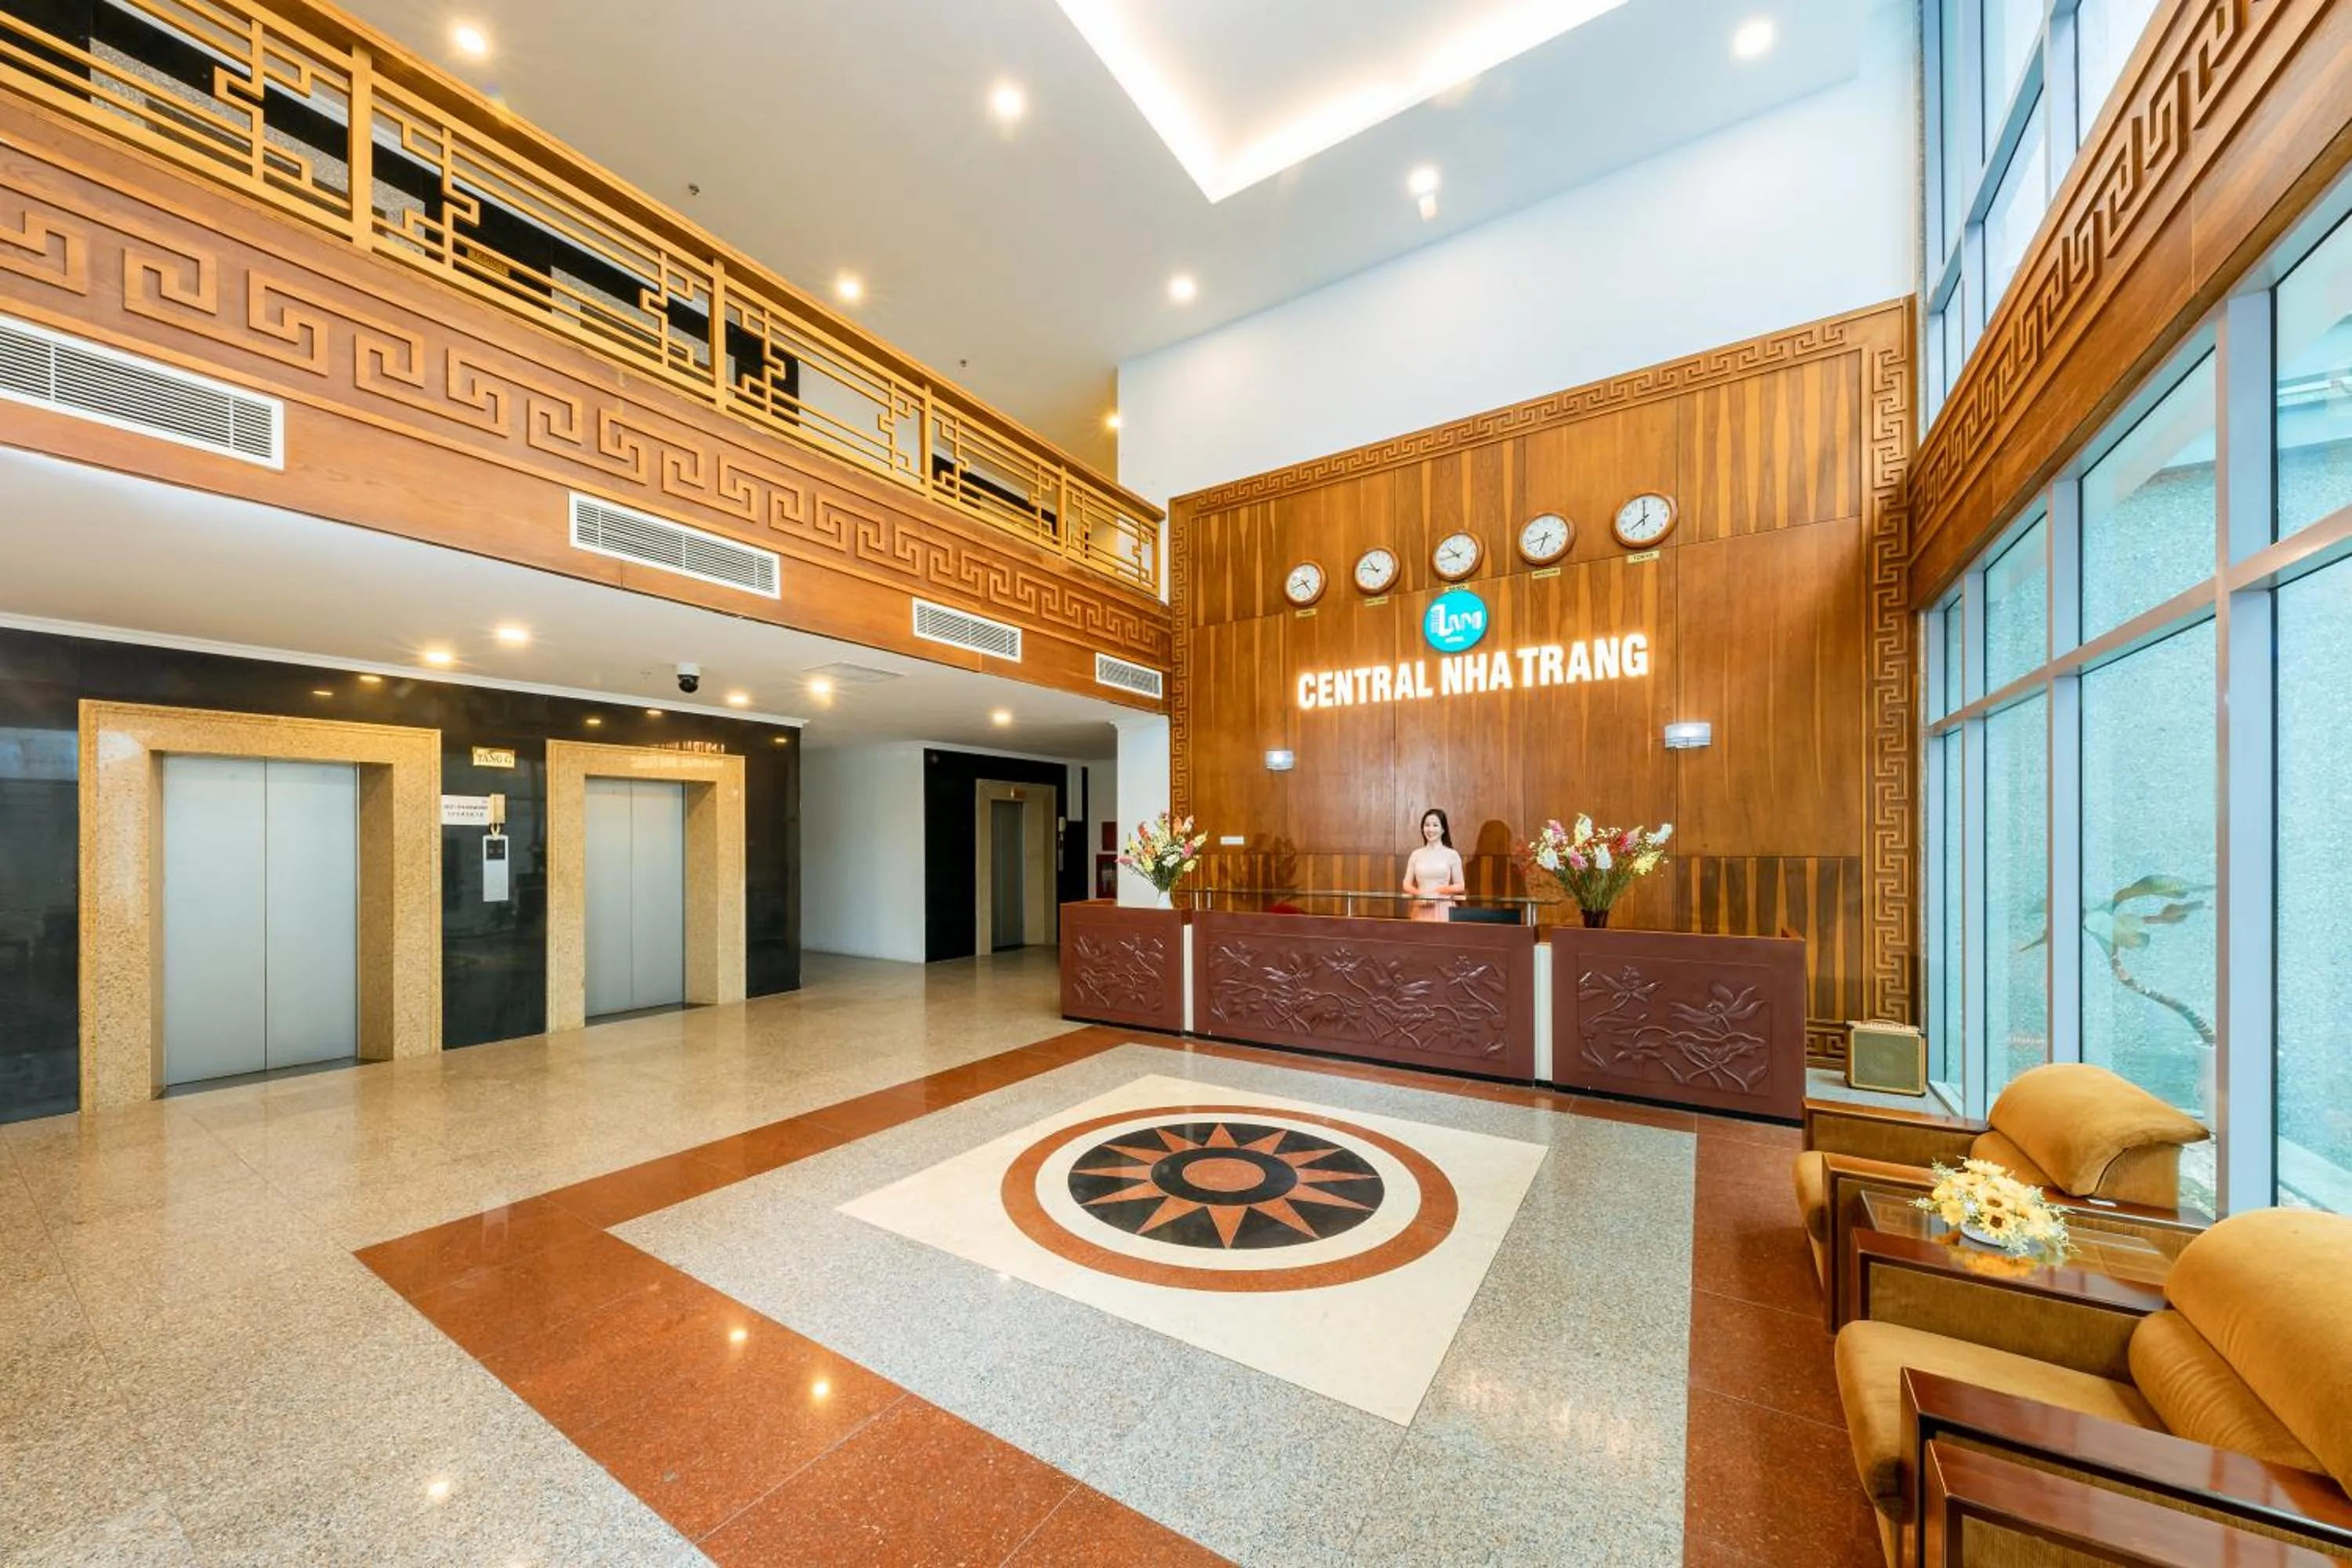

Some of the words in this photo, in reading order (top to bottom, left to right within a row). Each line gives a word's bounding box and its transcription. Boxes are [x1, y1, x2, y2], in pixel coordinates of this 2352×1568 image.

[1298, 661, 1433, 709] CENTRAL
[1441, 652, 1513, 696] NHA
[1516, 633, 1649, 687] TRANG
